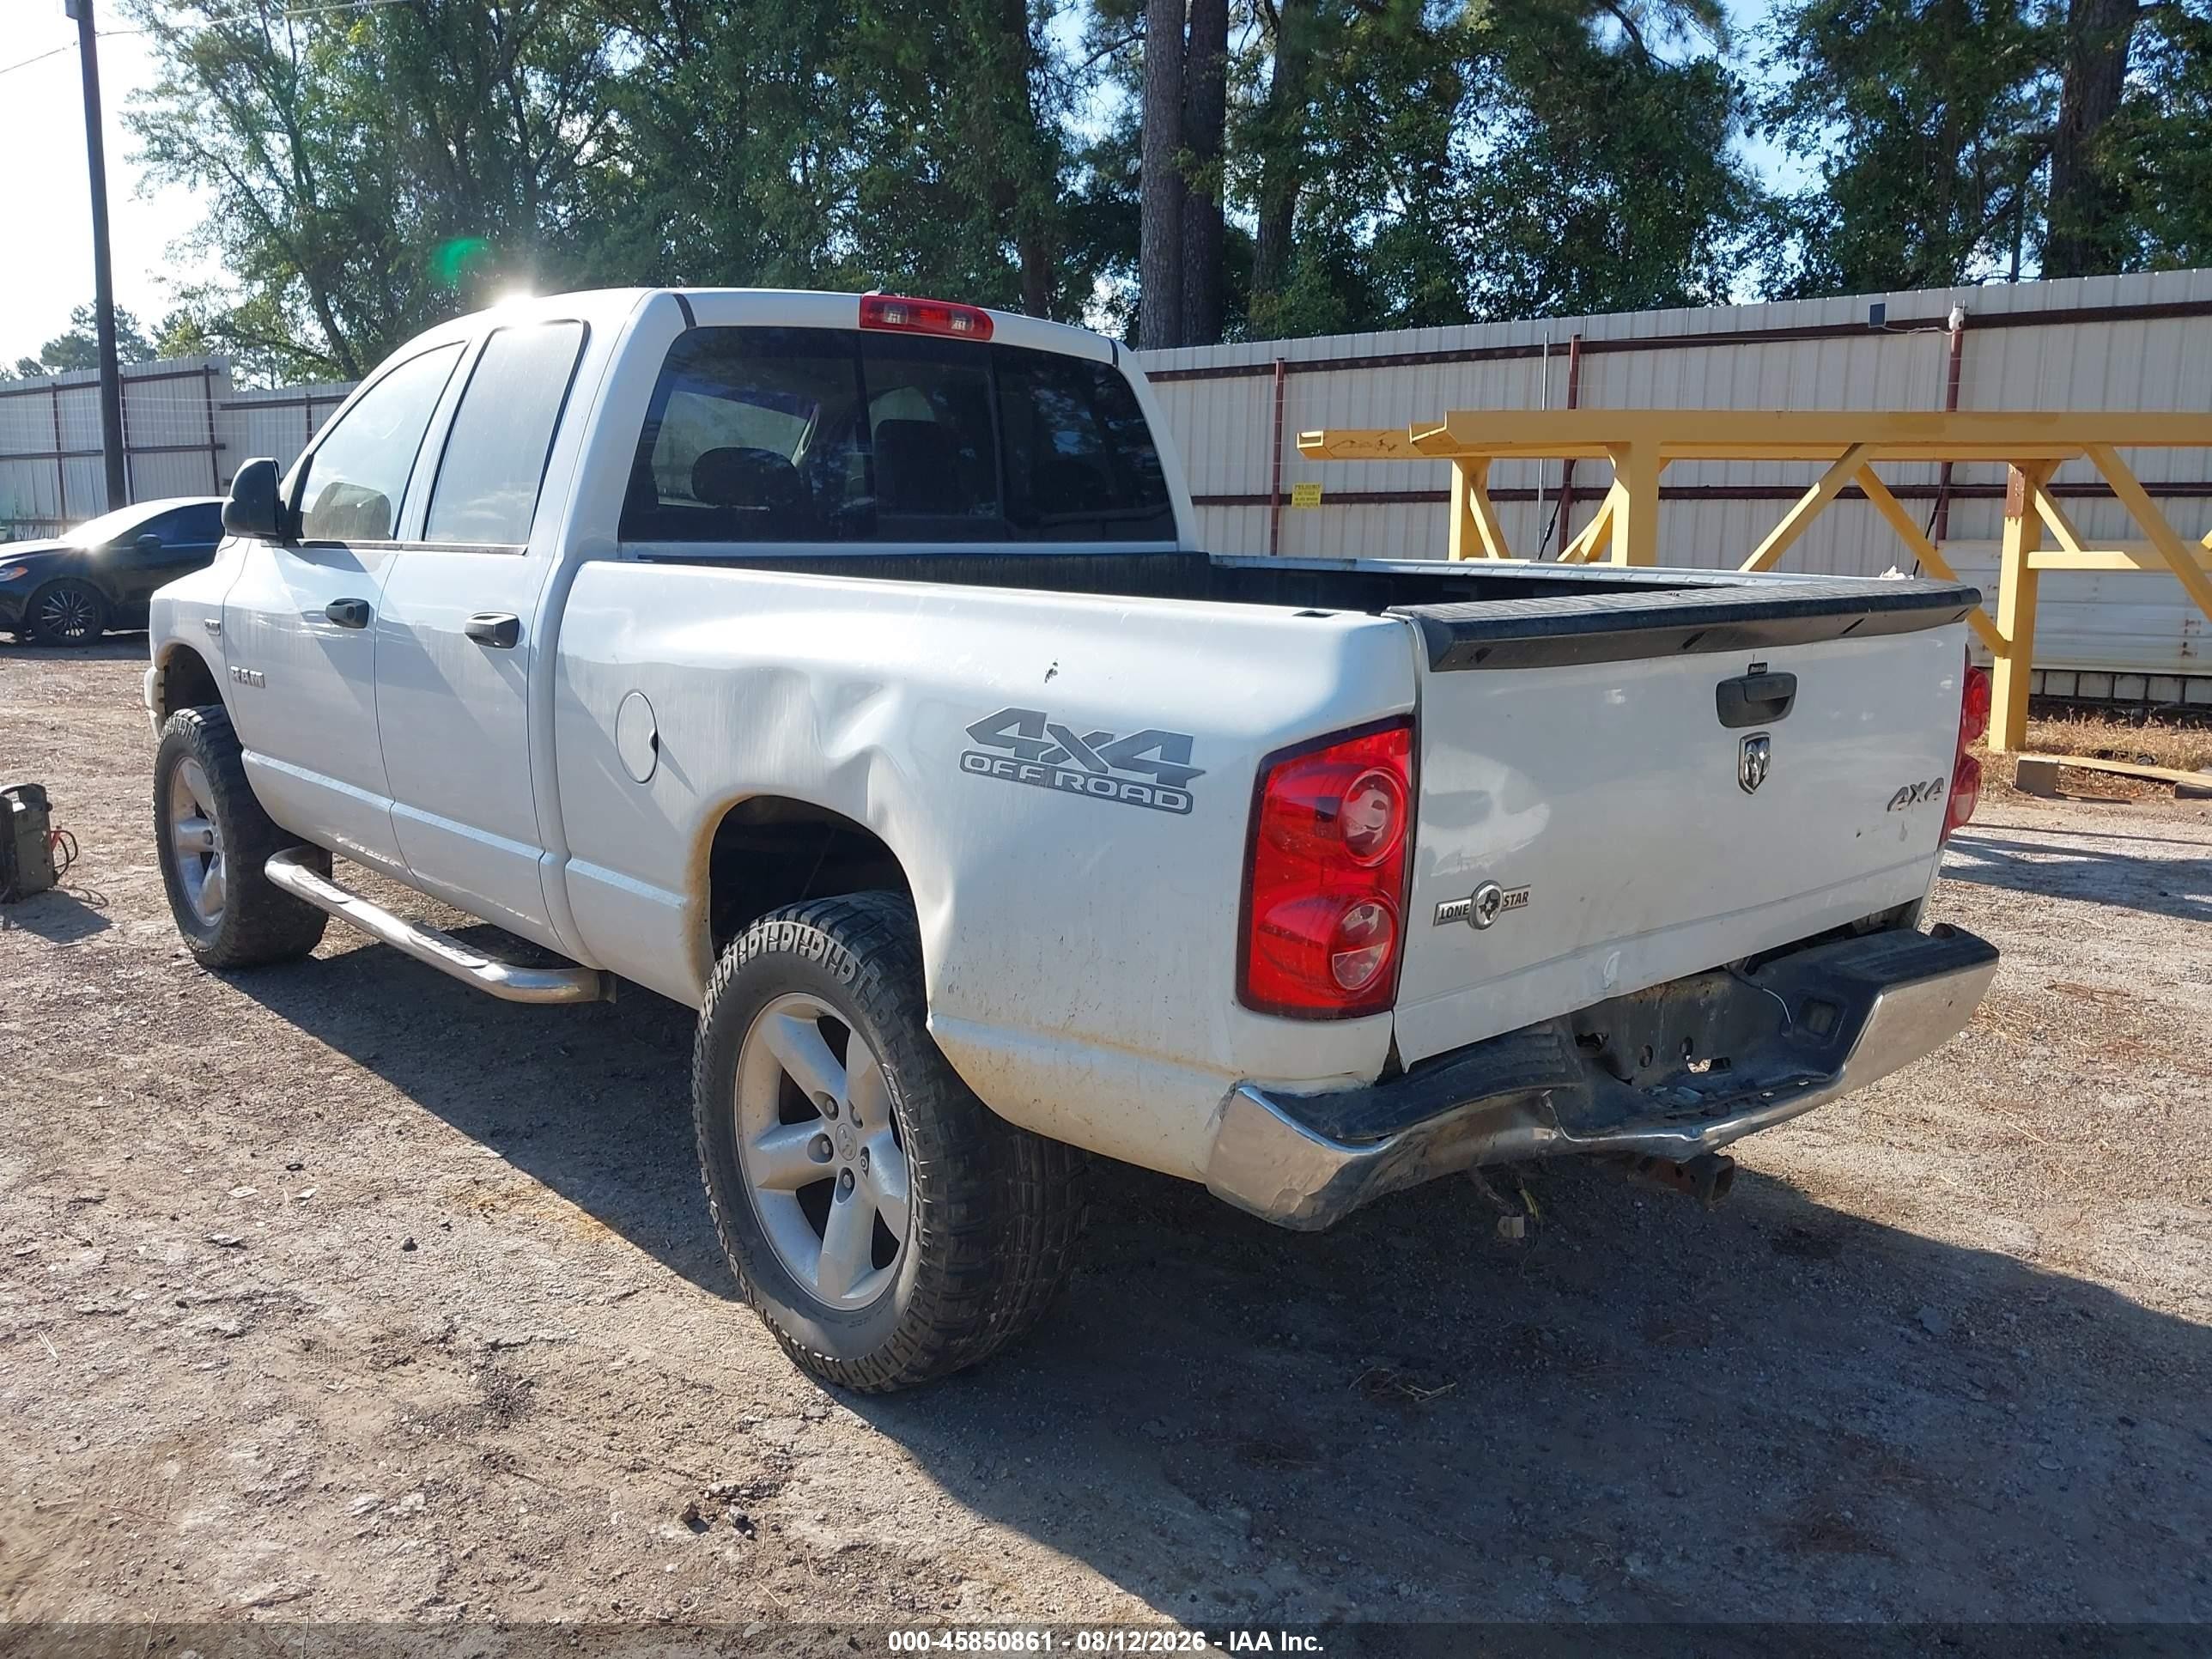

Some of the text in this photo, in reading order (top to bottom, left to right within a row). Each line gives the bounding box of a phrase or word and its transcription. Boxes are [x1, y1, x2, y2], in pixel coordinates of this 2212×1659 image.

[963, 753, 1188, 811] OFF ROAD
[1438, 890, 1529, 920] LONE STAR
